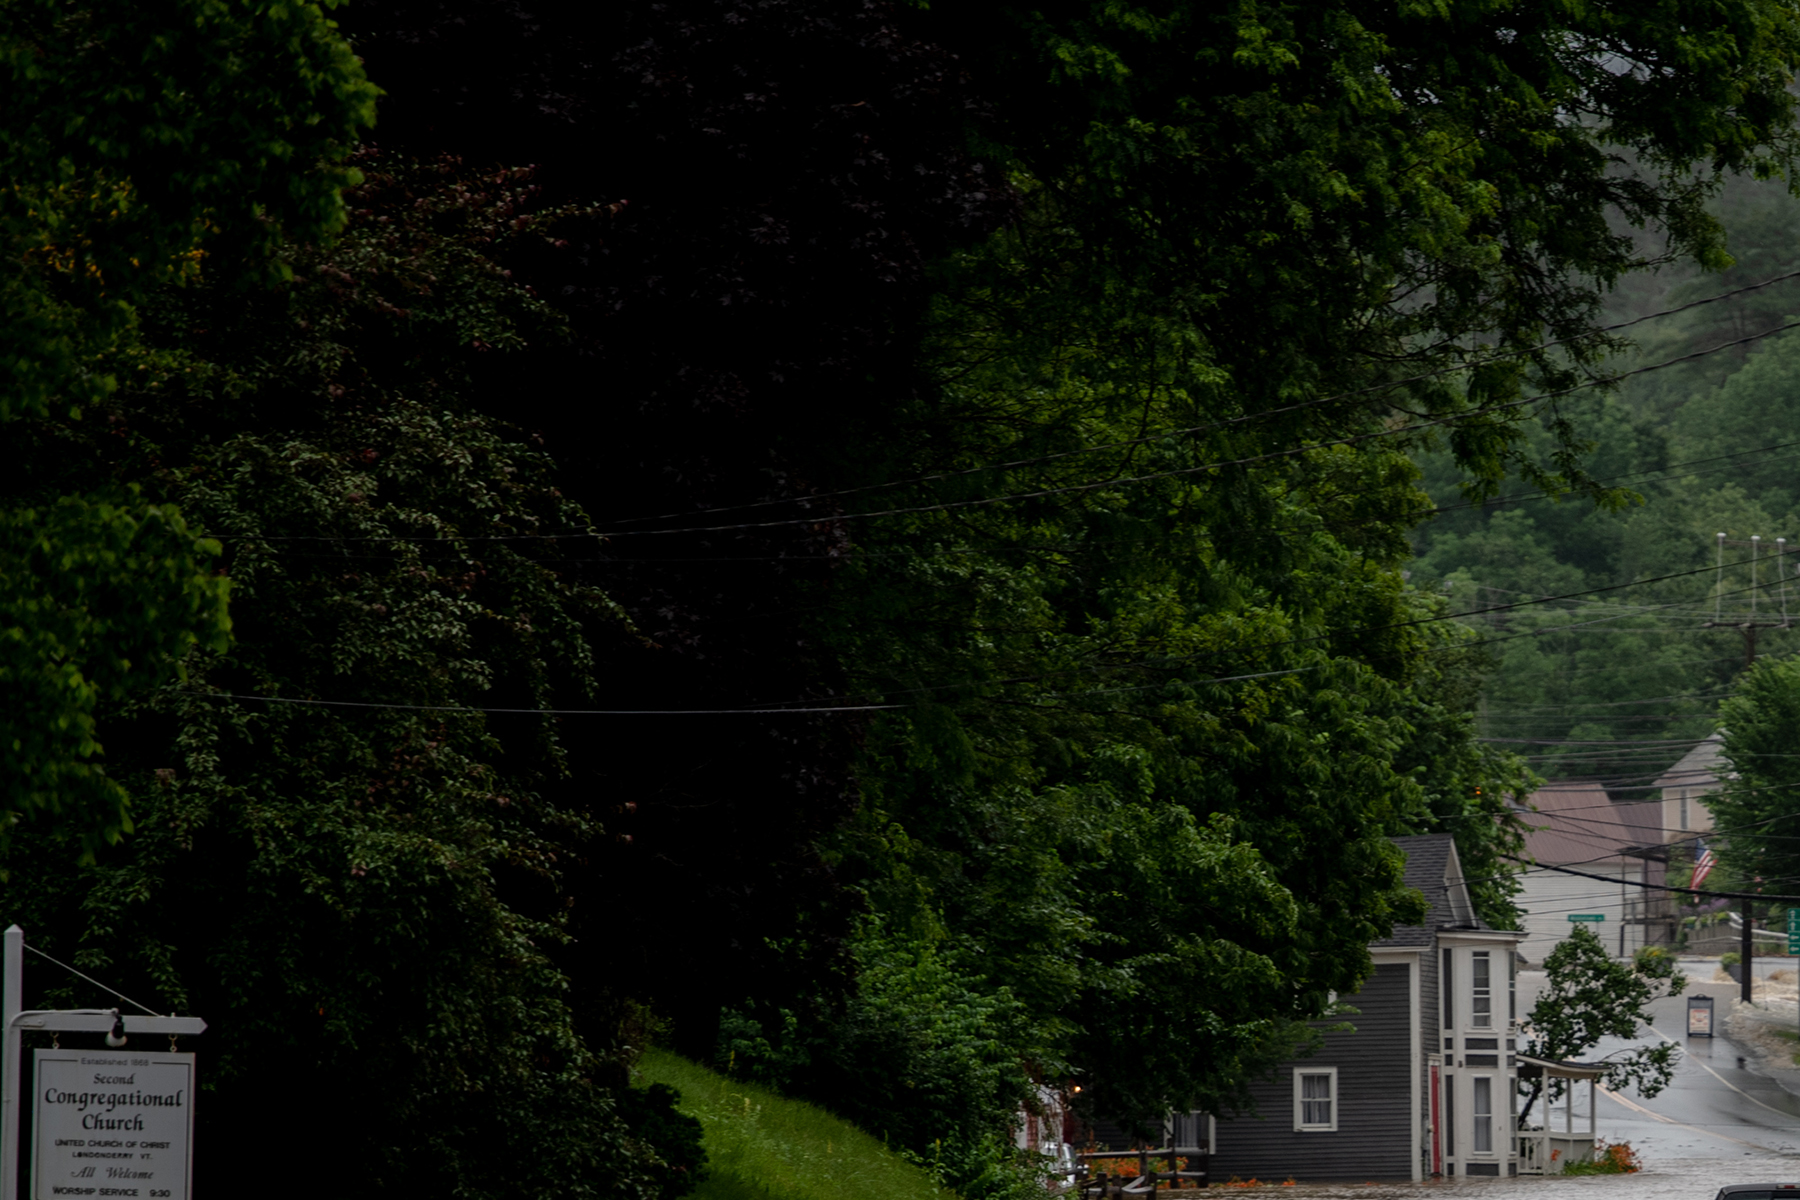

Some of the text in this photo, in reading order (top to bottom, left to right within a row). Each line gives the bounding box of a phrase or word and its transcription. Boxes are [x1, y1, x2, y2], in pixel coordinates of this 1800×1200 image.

[81, 1057, 128, 1066] Established
[93, 1073, 136, 1085] Second
[45, 1088, 183, 1112] Congregational
[82, 1113, 144, 1131] Church
[55, 1139, 85, 1147] UNITED
[88, 1140, 122, 1148] CHURCH
[140, 1141, 170, 1149] CHRIST
[71, 1166, 154, 1179] All Welcome
[53, 1187, 170, 1197] WORSHIP SERVICE 9:30
